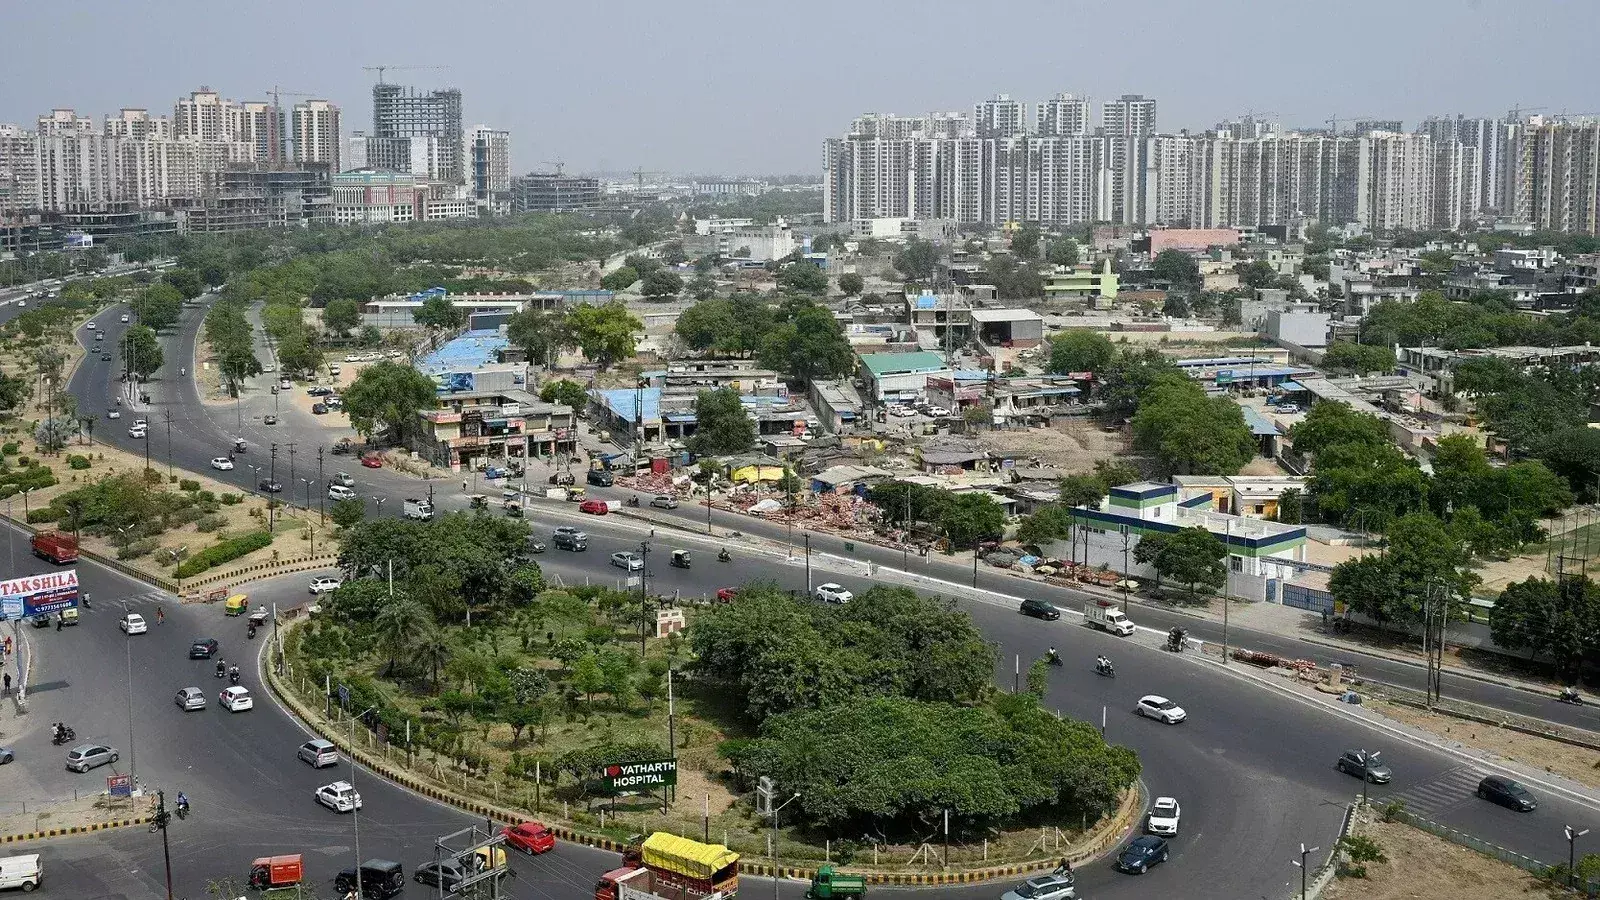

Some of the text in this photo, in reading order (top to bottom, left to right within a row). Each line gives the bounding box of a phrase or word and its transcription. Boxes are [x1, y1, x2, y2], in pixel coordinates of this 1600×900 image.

[0, 573, 77, 596] TAKSHILA
[604, 761, 676, 777] I YATHARTH
[613, 774, 665, 787] HOSPITAL
